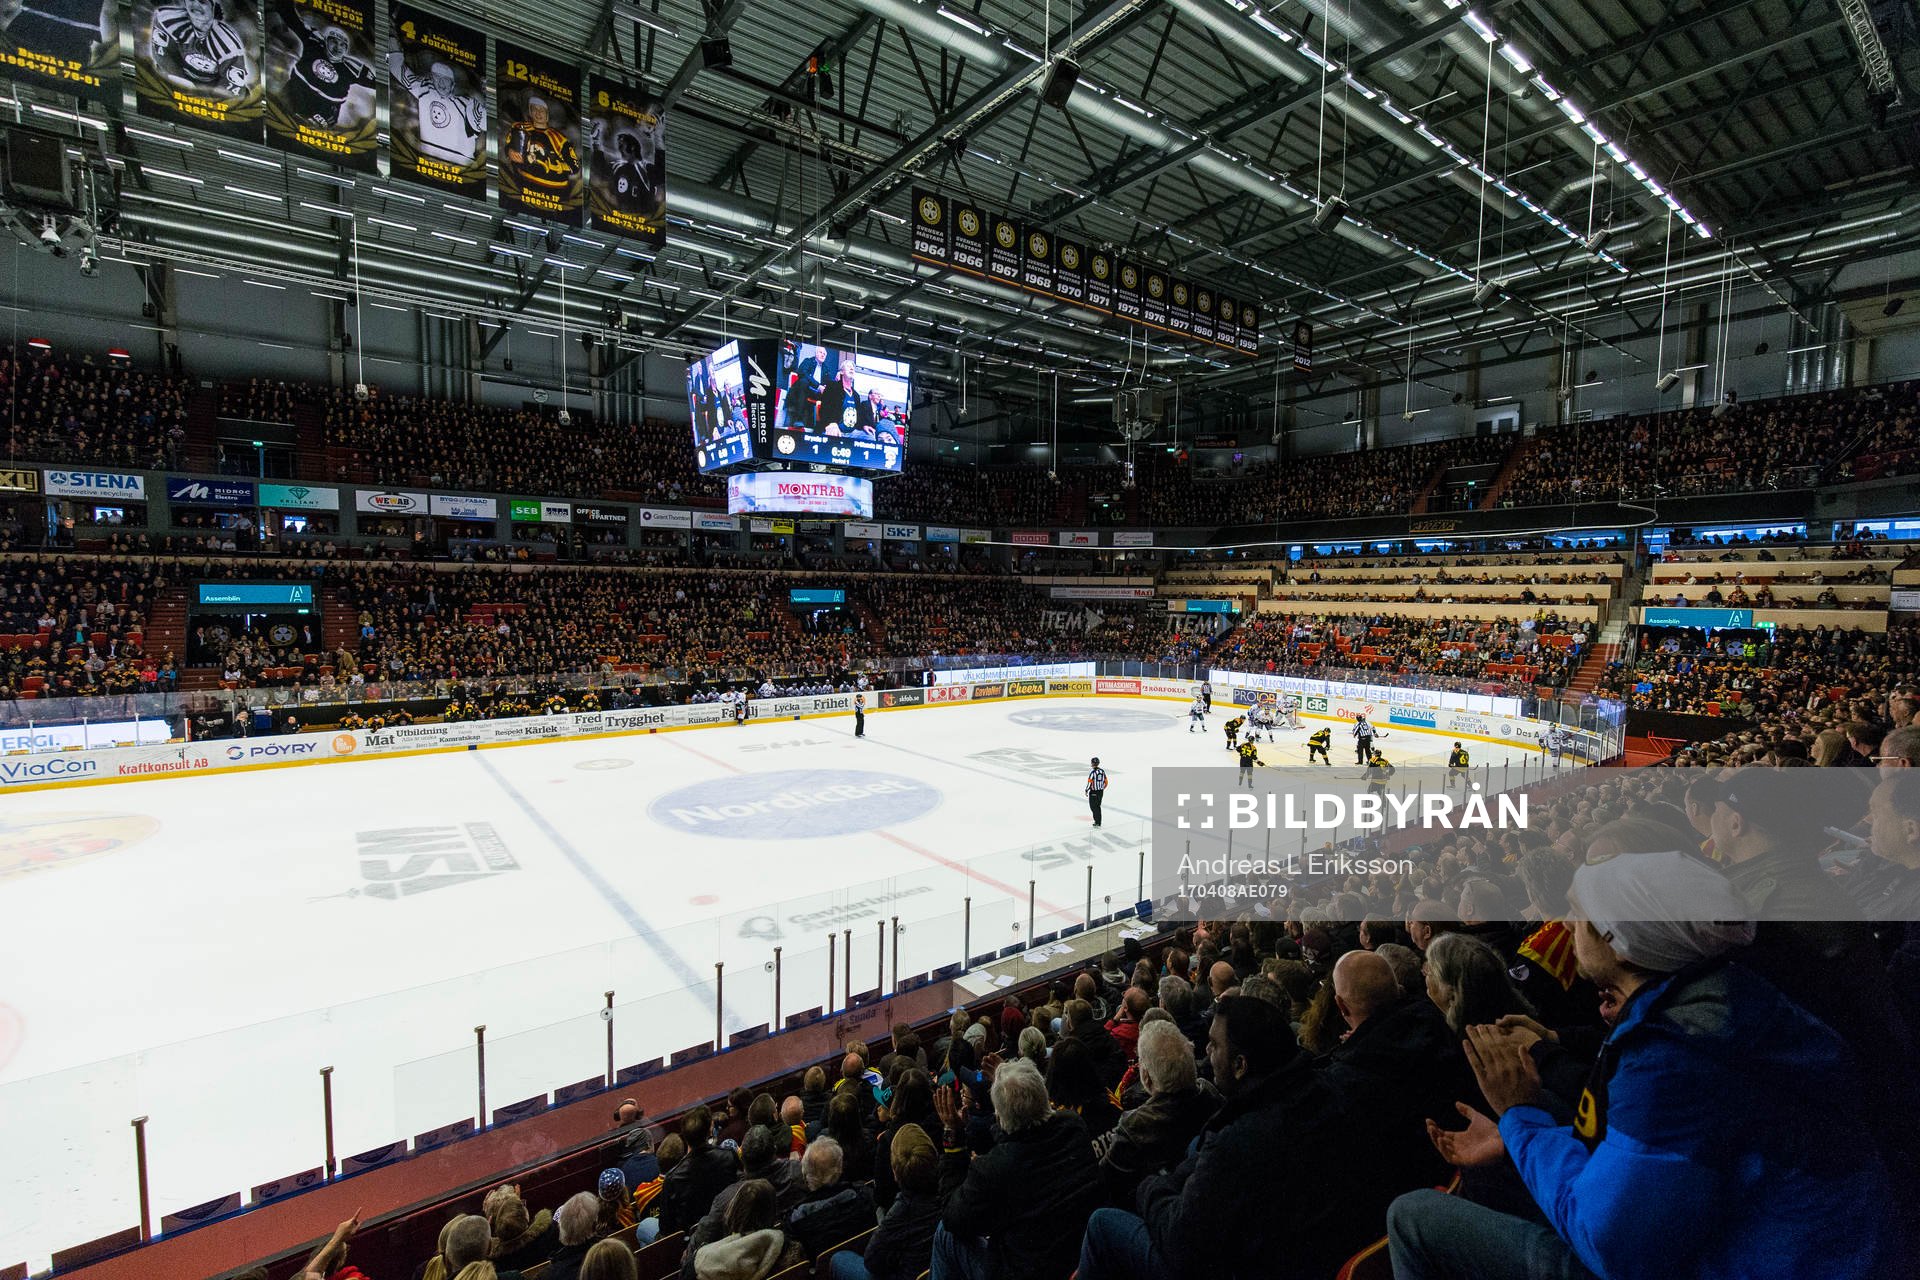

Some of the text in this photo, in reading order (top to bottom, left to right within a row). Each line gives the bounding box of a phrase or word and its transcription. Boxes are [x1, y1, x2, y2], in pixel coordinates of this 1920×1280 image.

[400, 21, 417, 40] 4
[506, 59, 528, 81] 12
[916, 224, 944, 237] SVENSKA
[914, 240, 946, 258] 1964
[953, 250, 983, 268] 1966
[991, 262, 1019, 278] 1967
[1025, 273, 1051, 288] 1968
[1057, 283, 1082, 298] 1970
[1088, 292, 1110, 306] 1971
[1117, 302, 1140, 316] 1972
[1144, 310, 1166, 323] 1976
[1170, 318, 1189, 330] 1977
[1193, 324, 1213, 337] 1980
[1216, 332, 1235, 344] 1993
[1239, 339, 1257, 351] 1999
[1294, 355, 1311, 366] 2012
[812, 445, 819, 454] 1
[863, 451, 869, 460] 1
[70, 473, 139, 490] STENA
[59, 488, 97, 496] Innovative
[778, 483, 845, 498] MONTRAB
[886, 527, 916, 537] SKF
[1008, 682, 1043, 695] Cheers
[774, 703, 800, 713] Lycka
[813, 697, 849, 710] Frihet
[721, 705, 758, 719] Failj
[1389, 707, 1436, 721] SANDVIK
[574, 714, 602, 725] Fred
[605, 712, 665, 728] Trygghet
[688, 716, 720, 725] Kunskap
[396, 726, 448, 738] Utbildning
[495, 729, 523, 737] Respekt
[525, 725, 558, 735] Kärlek
[365, 735, 395, 747] Mat
[439, 735, 481, 743] Kamratskap
[250, 743, 317, 757] PÖYRY
[2, 759, 96, 778] ViaCon
[119, 758, 208, 775] Kraftkonsult AB
[669, 779, 918, 825] NordicBet
